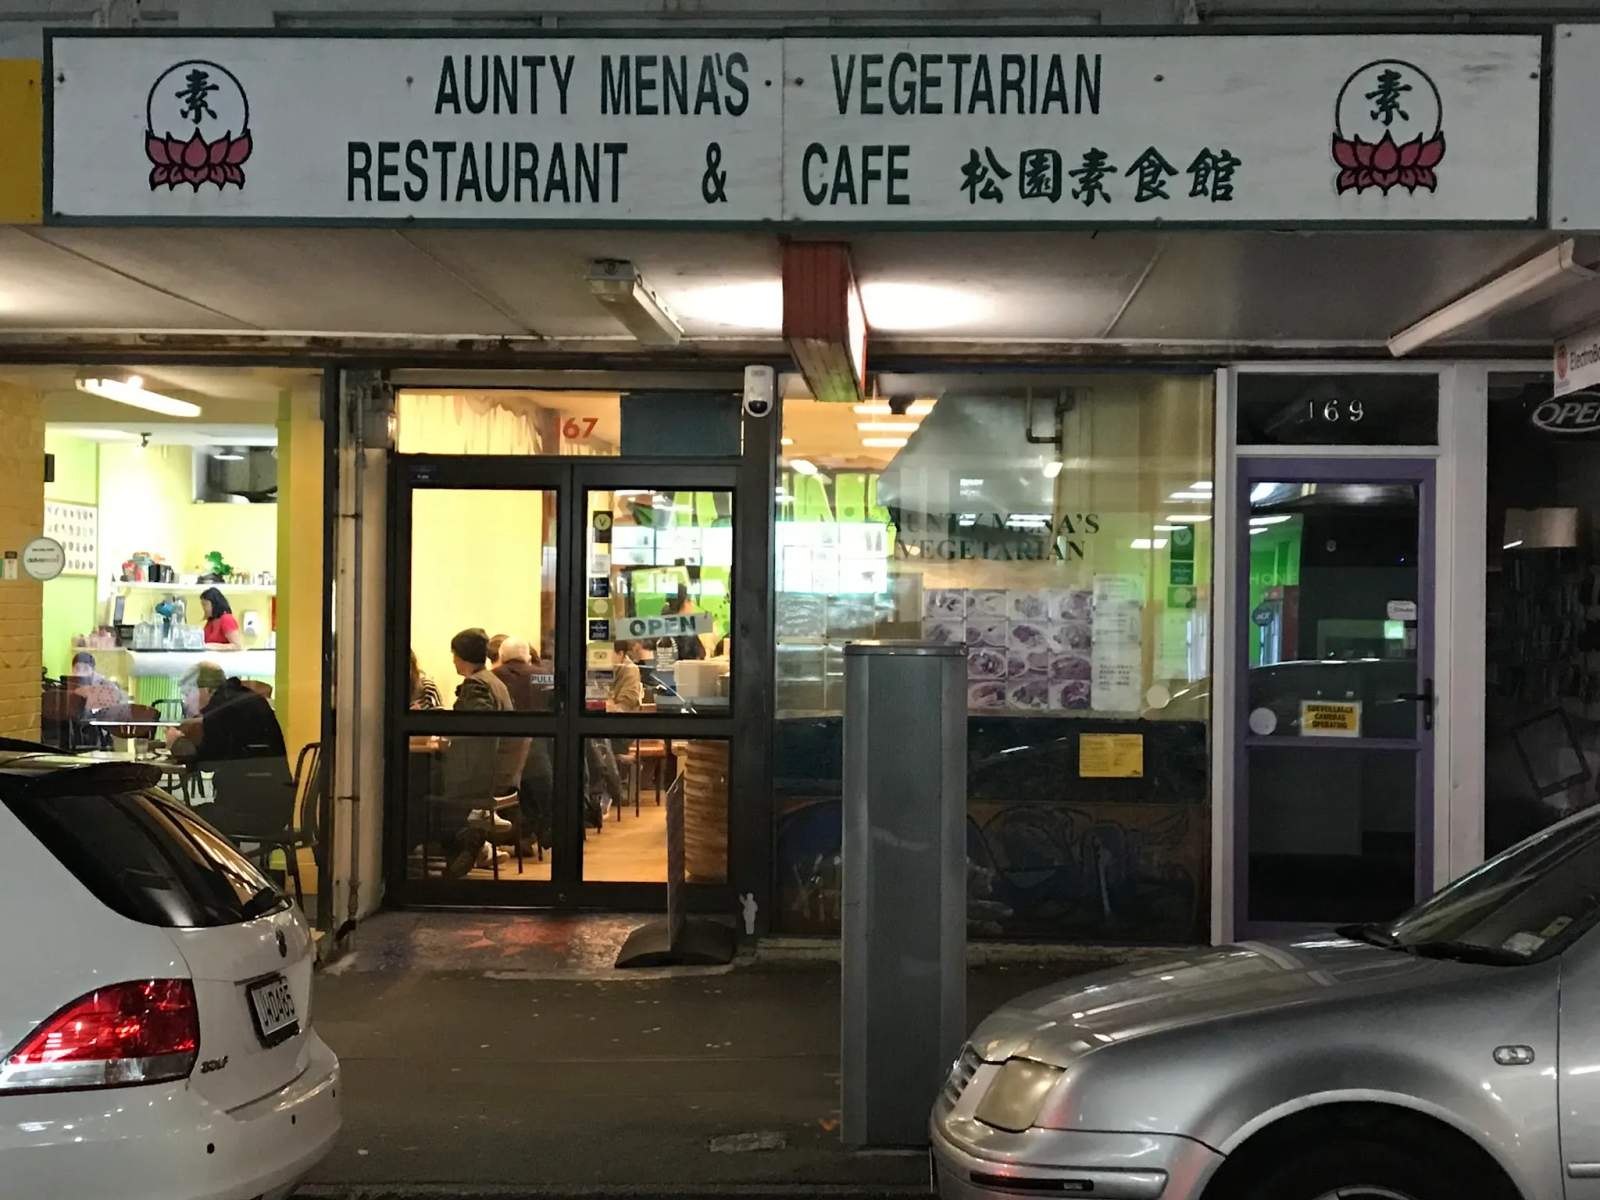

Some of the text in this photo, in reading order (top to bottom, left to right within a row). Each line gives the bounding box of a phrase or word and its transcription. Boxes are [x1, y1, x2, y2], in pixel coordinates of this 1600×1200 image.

[174, 68, 220, 125] 素
[435, 52, 1102, 117] AUNTY MENA'S VEGETARIAN
[1365, 69, 1412, 126] 素
[347, 140, 911, 206] RESTAURANT & CAFE
[959, 145, 1242, 207] 松園素食館
[1308, 398, 1365, 422] 169
[629, 615, 697, 637] OPEN
